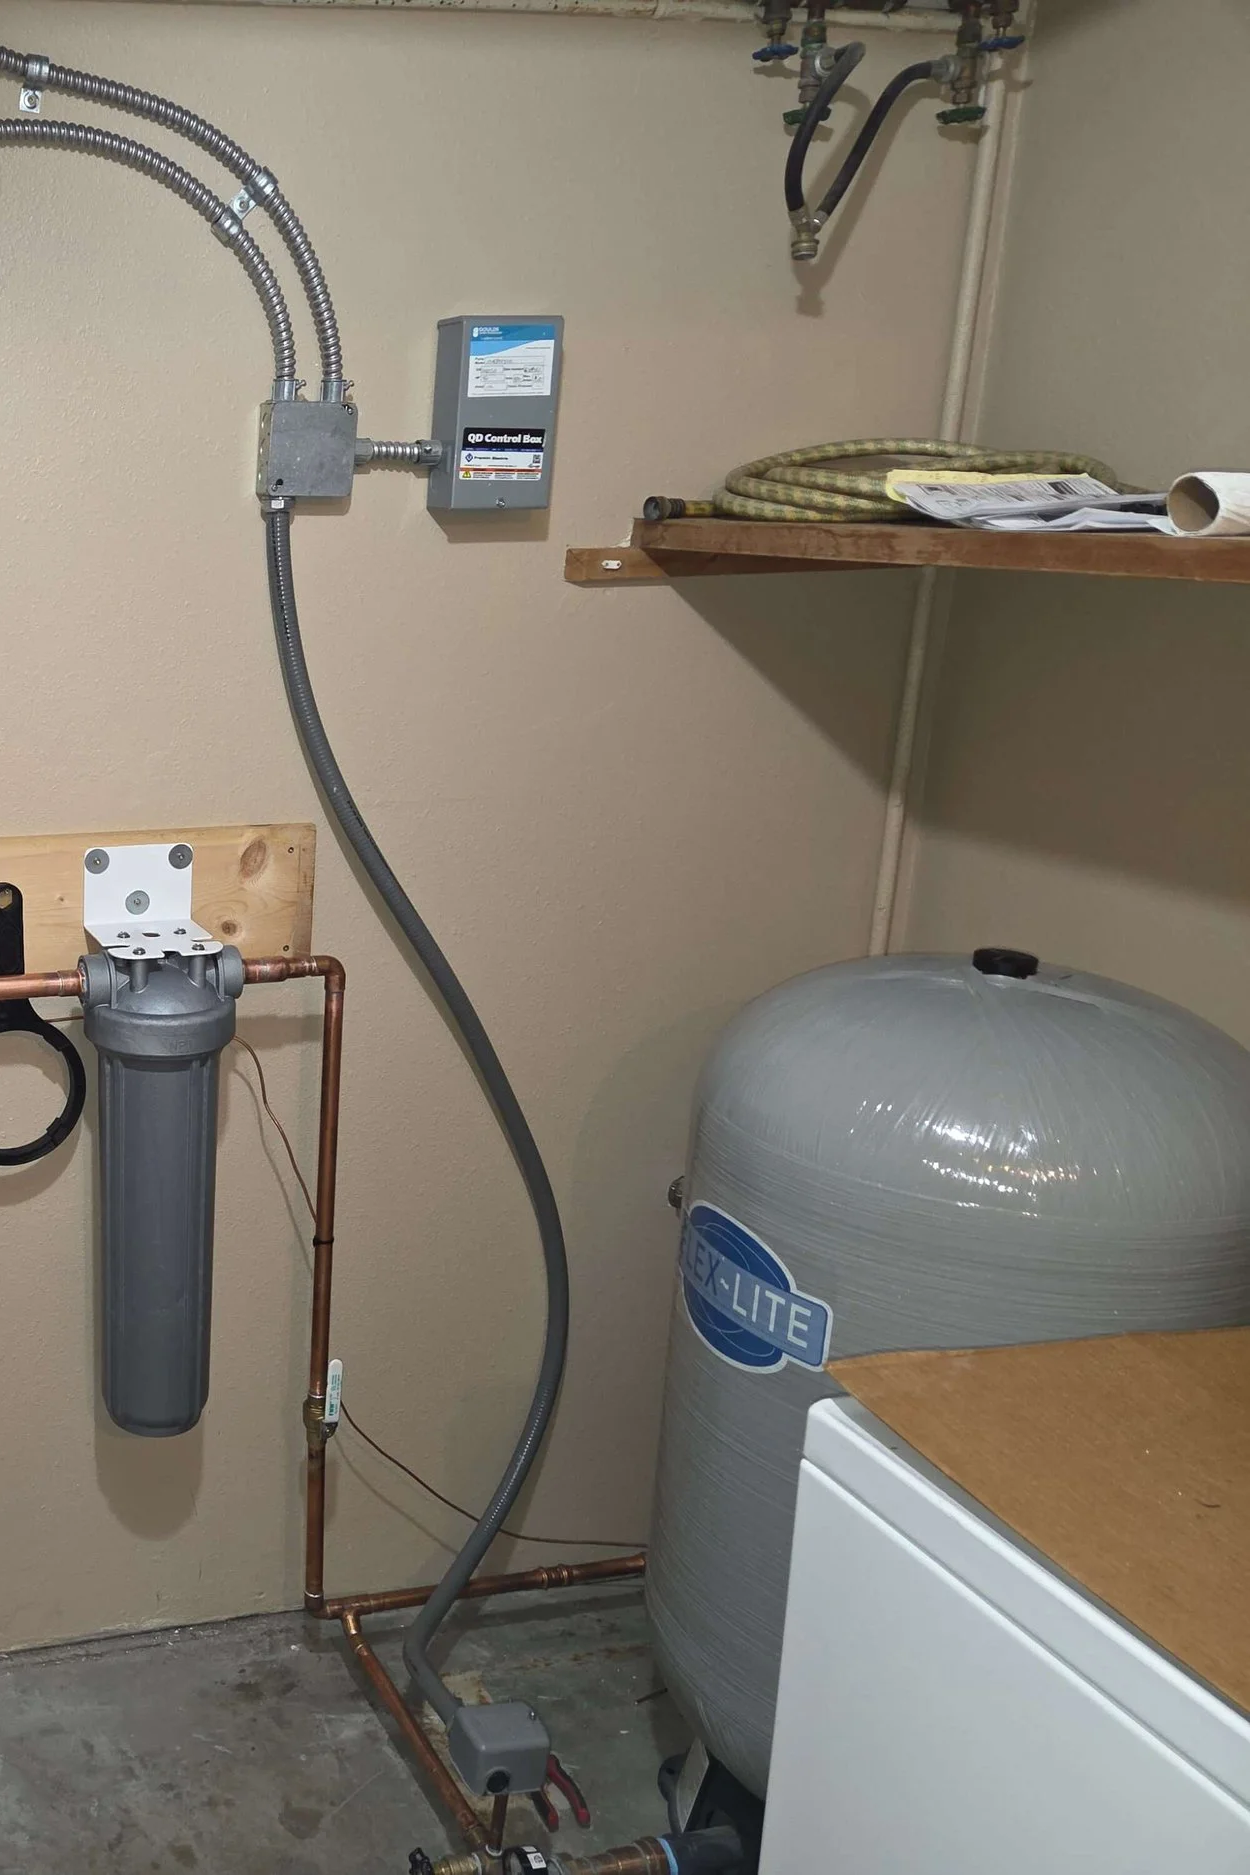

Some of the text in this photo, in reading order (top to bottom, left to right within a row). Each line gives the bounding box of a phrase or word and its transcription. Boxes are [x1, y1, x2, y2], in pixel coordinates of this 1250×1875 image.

[467, 433, 543, 444] QD Control Box
